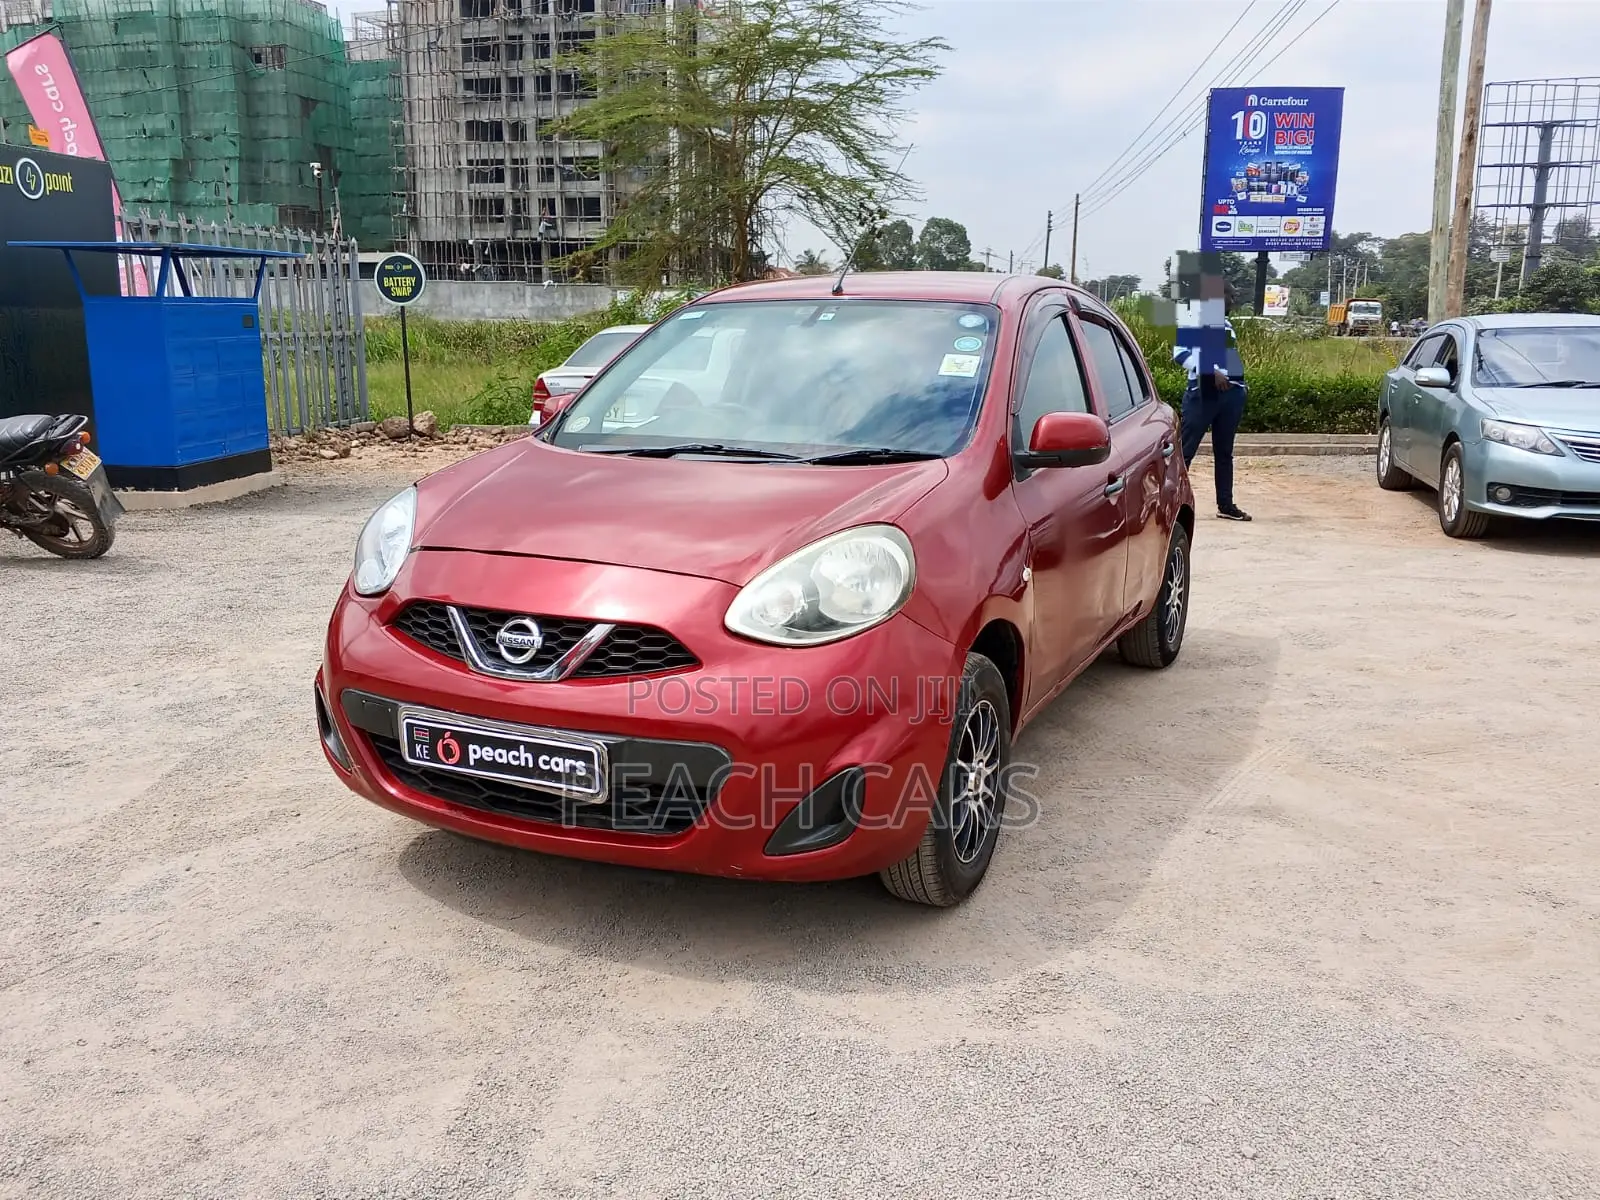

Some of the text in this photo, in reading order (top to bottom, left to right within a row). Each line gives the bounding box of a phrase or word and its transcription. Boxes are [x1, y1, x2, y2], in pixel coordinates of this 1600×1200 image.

[1260, 96, 1309, 106] Carrefour
[1231, 111, 1267, 140] 10
[1273, 112, 1315, 129] WIN
[1274, 130, 1315, 146] BIG!
[45, 172, 74, 195] point
[383, 276, 416, 287] BATTERY
[391, 286, 412, 297] SWAP
[499, 636, 536, 647] NISSAN
[414, 743, 431, 760] KE
[468, 743, 587, 777] peach cars
